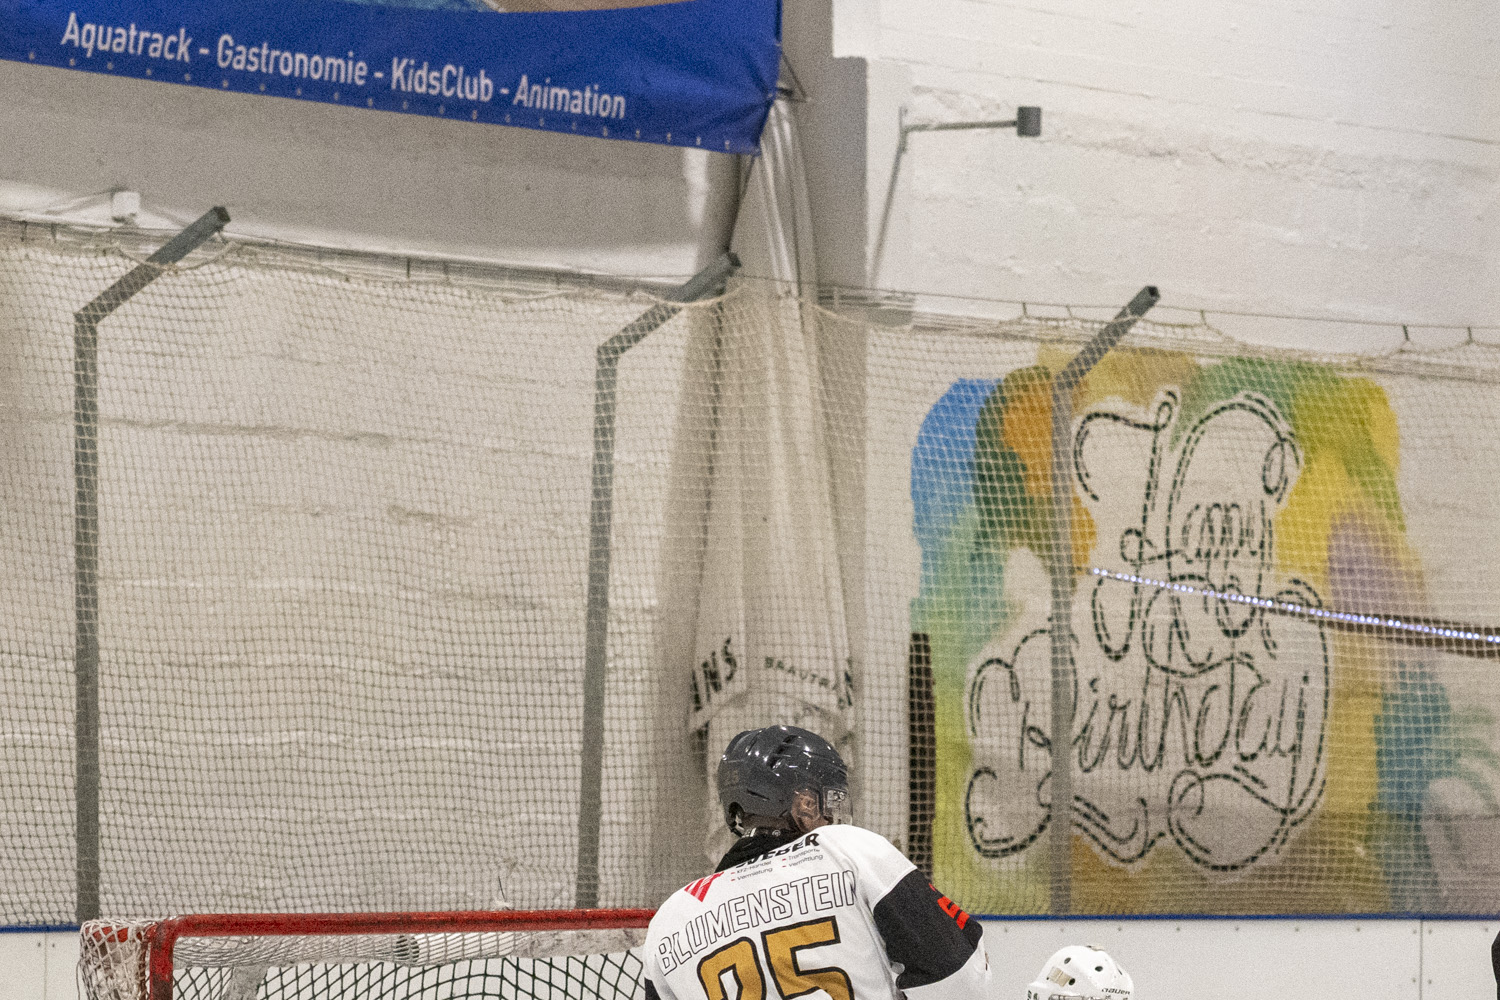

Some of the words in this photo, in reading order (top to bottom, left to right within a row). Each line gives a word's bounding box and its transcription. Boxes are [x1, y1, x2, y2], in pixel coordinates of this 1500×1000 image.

[61, 11, 192, 63] Aquatrack
[217, 34, 368, 86] Gastronomie
[391, 57, 493, 102] KidsClub
[513, 74, 626, 119] Animation
[656, 869, 857, 977] BLUMENSTEIN
